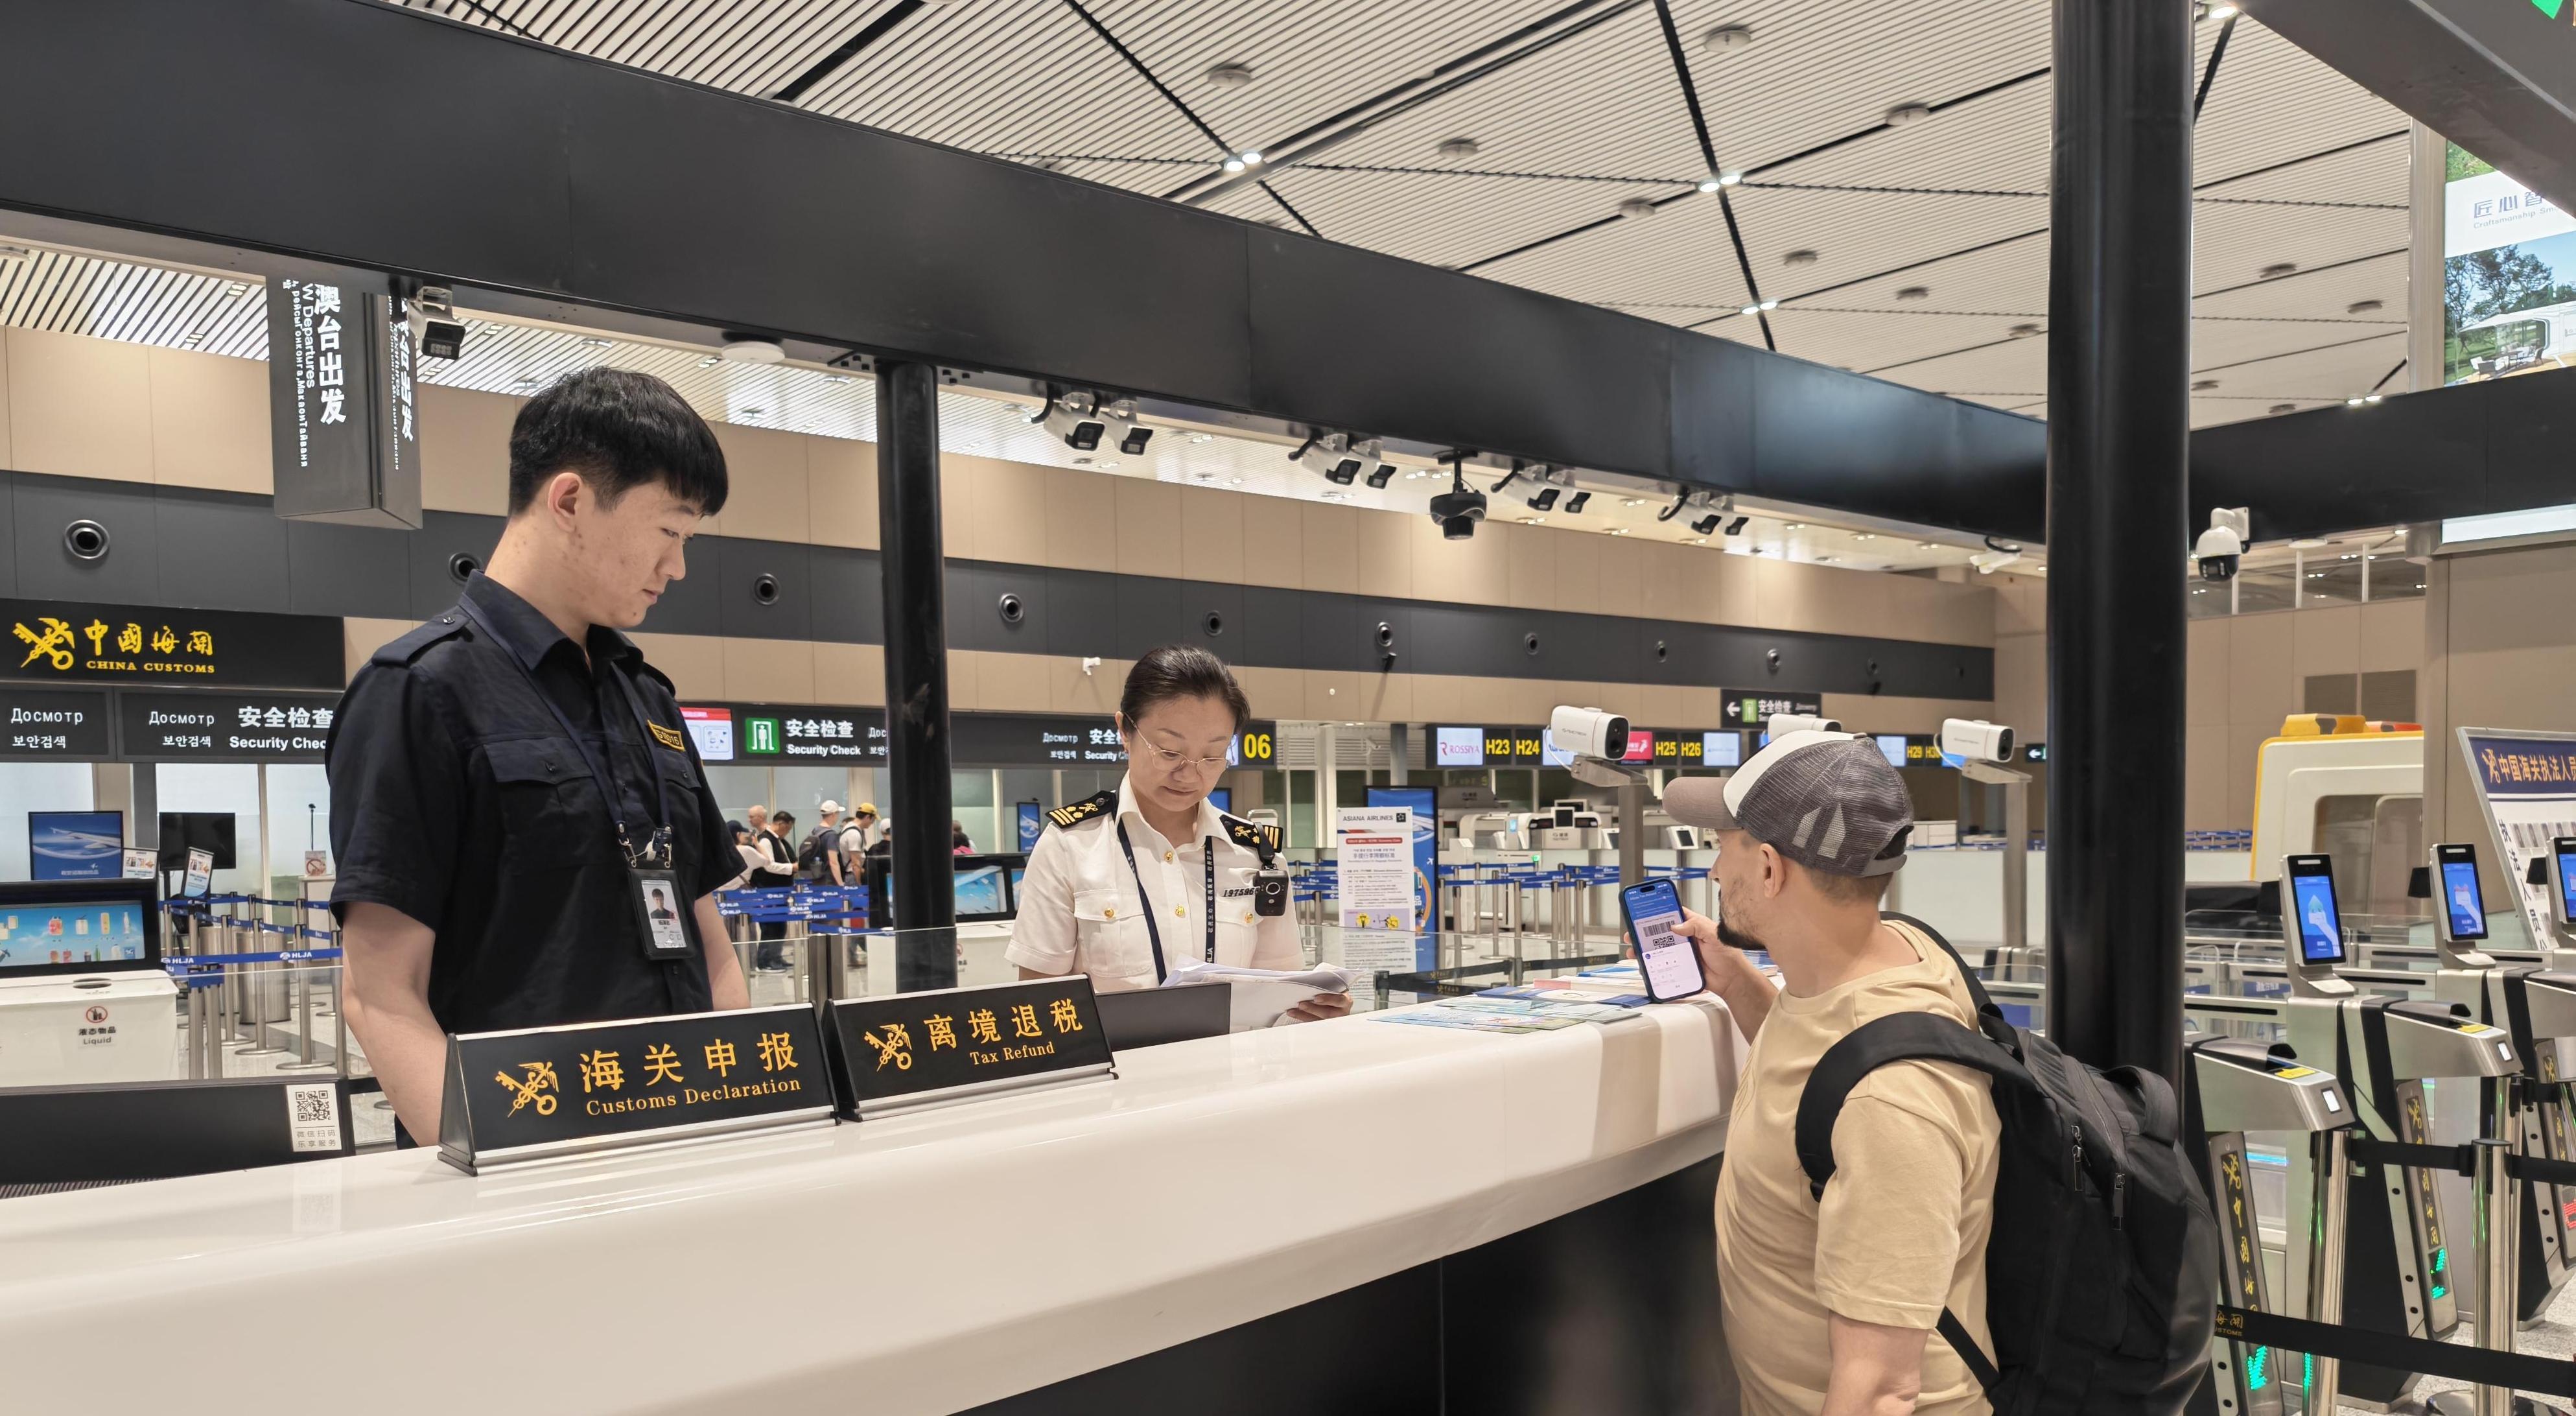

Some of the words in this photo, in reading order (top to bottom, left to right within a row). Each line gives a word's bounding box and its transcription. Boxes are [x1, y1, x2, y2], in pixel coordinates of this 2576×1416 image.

[2474, 211, 2536, 229] Craftsmanship
[302, 306, 316, 389] Departures
[314, 283, 347, 425] 澳台出发
[86, 660, 137, 671] CHINA
[143, 663, 215, 674] CUSTOMS
[11, 708, 83, 725] Досмотр
[148, 711, 215, 727] Досмотр
[238, 706, 334, 729] 安全检查
[785, 718, 854, 738] 安全检查
[868, 727, 887, 738] Дос
[12, 735, 67, 749] 보안검색
[162, 735, 211, 748] 보안검색
[229, 736, 288, 751] Security
[292, 737, 326, 749] Chec
[1042, 732, 1079, 744] Досмотр
[787, 744, 828, 757] Security
[831, 744, 861, 755] Check
[869, 746, 888, 756] 보안
[1243, 734, 1272, 759] 06
[1449, 745, 1480, 754] ROSSIYA
[1486, 738, 1510, 755] H23
[1516, 740, 1540, 755] H24
[1656, 741, 1677, 756] H25
[1681, 742, 1702, 757] H26
[1907, 746, 1923, 759] H29
[1084, 750, 1117, 761] Security
[923, 997, 1083, 1052] 离境退税
[83, 1037, 112, 1045] Liquid
[970, 1048, 999, 1065] Tax
[1003, 1041, 1055, 1060] Refund
[579, 1032, 799, 1094] 海关申报
[586, 1095, 677, 1116] Customs
[684, 1077, 802, 1105] Declaration
